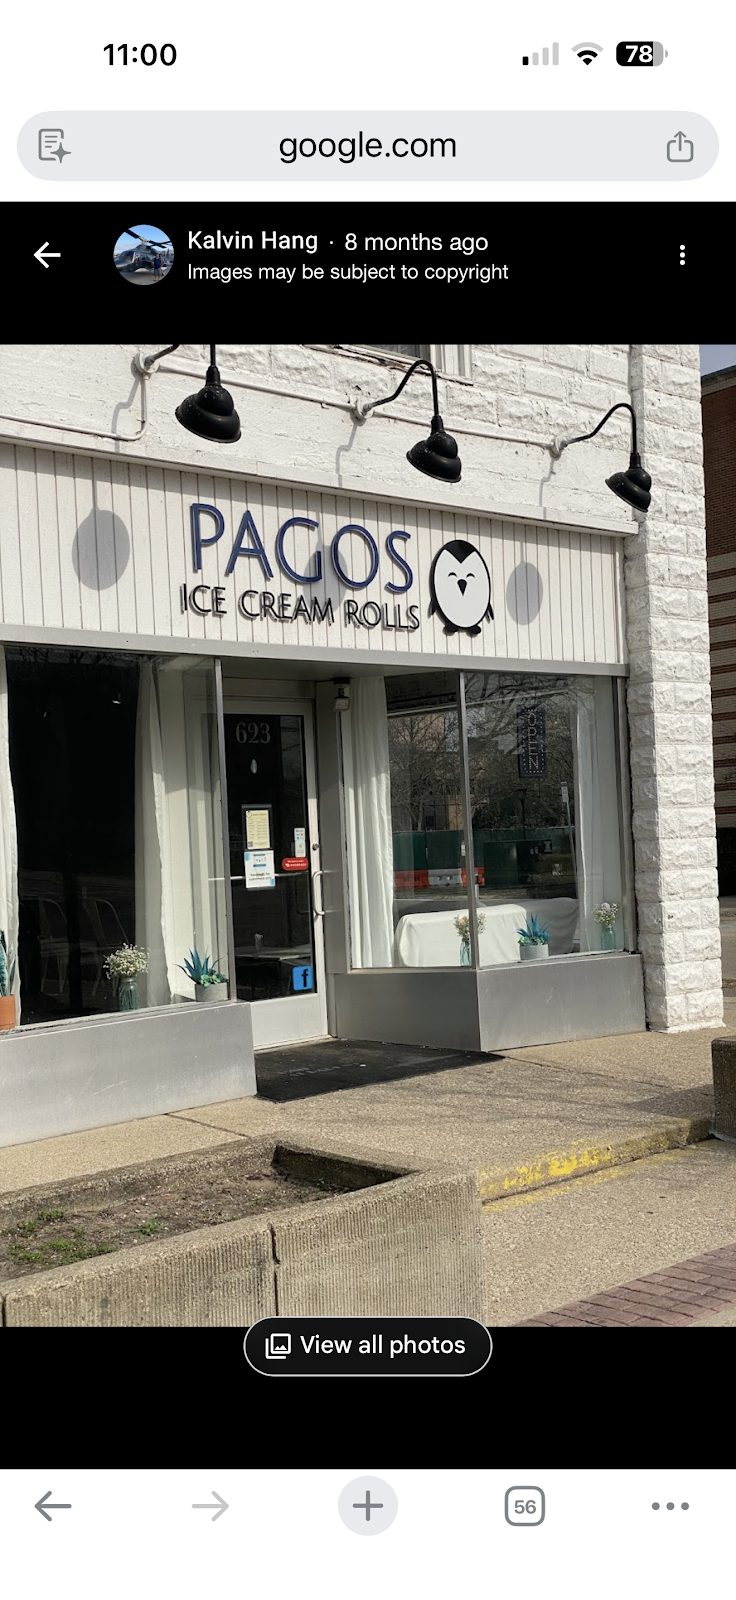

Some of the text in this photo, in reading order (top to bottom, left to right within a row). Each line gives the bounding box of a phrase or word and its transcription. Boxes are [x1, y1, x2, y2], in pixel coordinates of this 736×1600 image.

[190, 503, 413, 593] PAGOS
[179, 583, 420, 631] ICE CREAM ROLLS
[236, 722, 271, 744] 623
[527, 712, 539, 770] OPEN
